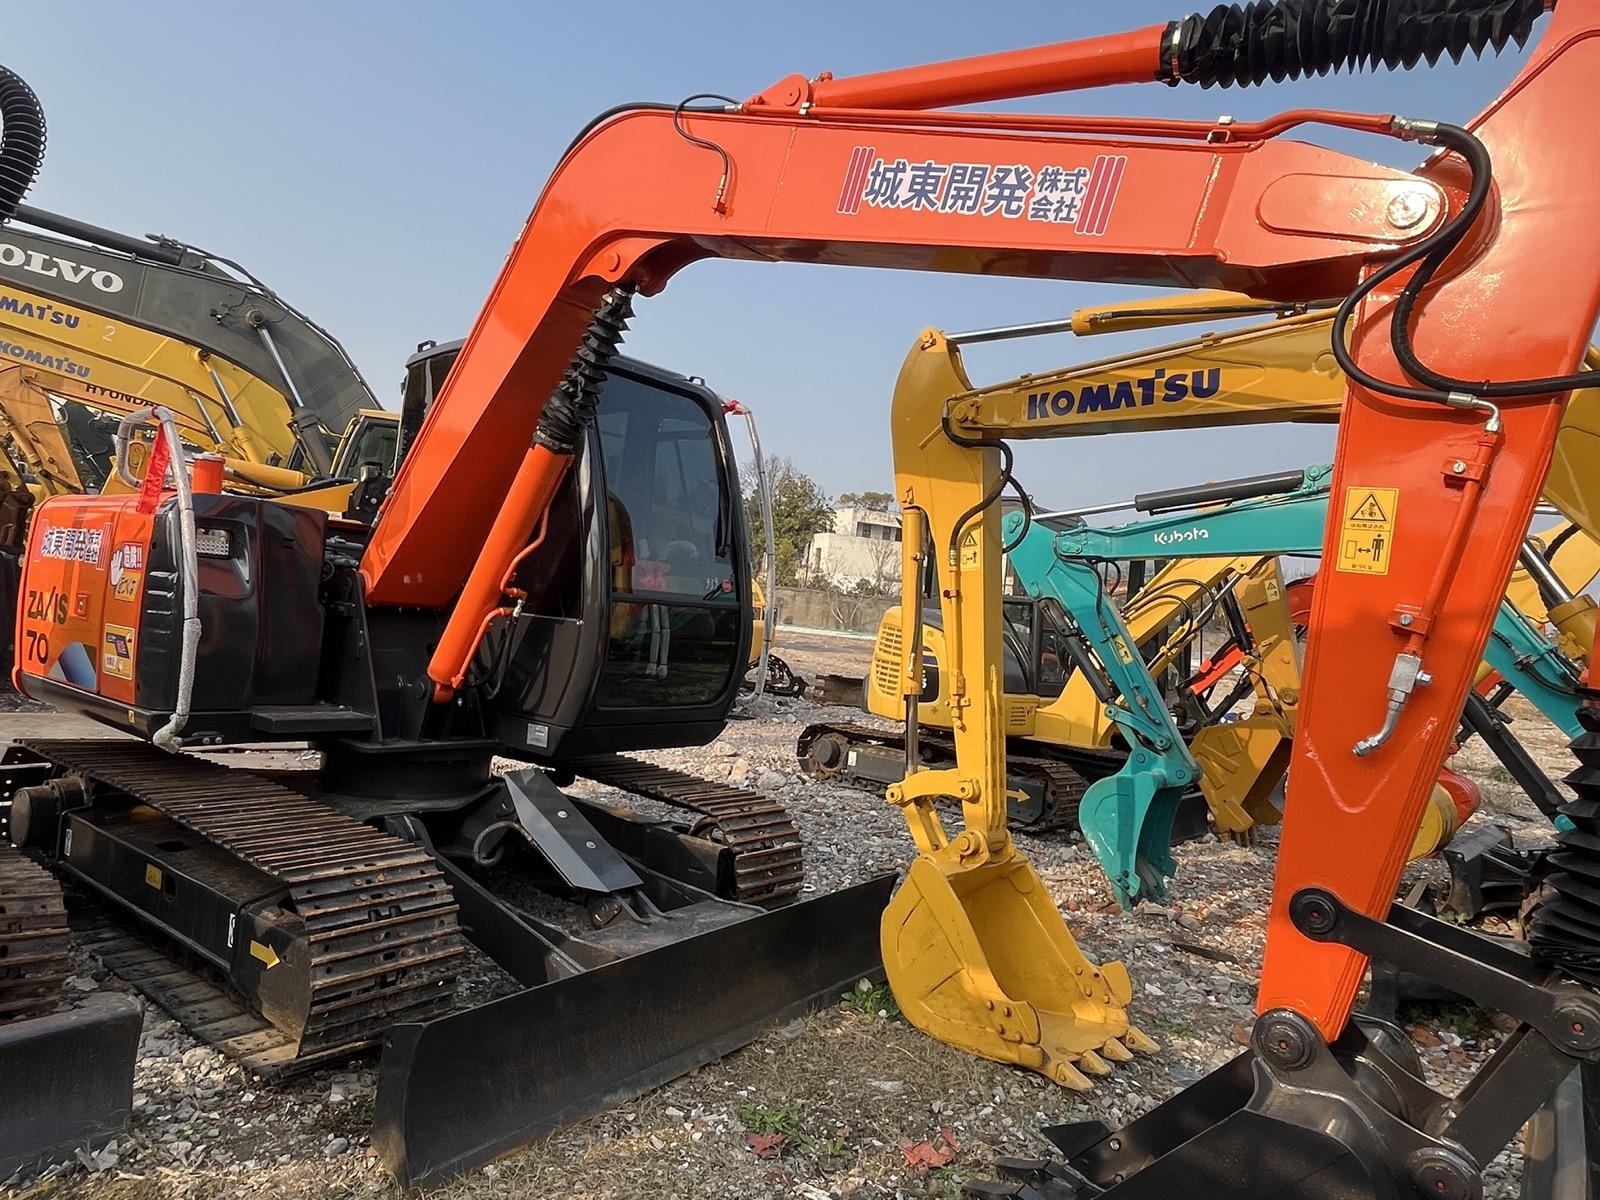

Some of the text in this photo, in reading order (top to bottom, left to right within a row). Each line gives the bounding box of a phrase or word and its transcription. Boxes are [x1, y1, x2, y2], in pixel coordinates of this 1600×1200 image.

[863, 159, 1033, 217] 城東開発
[1037, 167, 1088, 195] 株式
[1029, 194, 1079, 223] 会社
[0, 243, 124, 293] OLVO
[0, 296, 80, 328] MATSU
[102, 325, 116, 342] 2
[0, 340, 91, 378] KOMATSU
[85, 382, 156, 407] HYUNDA
[1027, 367, 1221, 421] KOMATSU
[1153, 527, 1209, 545] Kubota
[26, 629, 49, 664] 70
